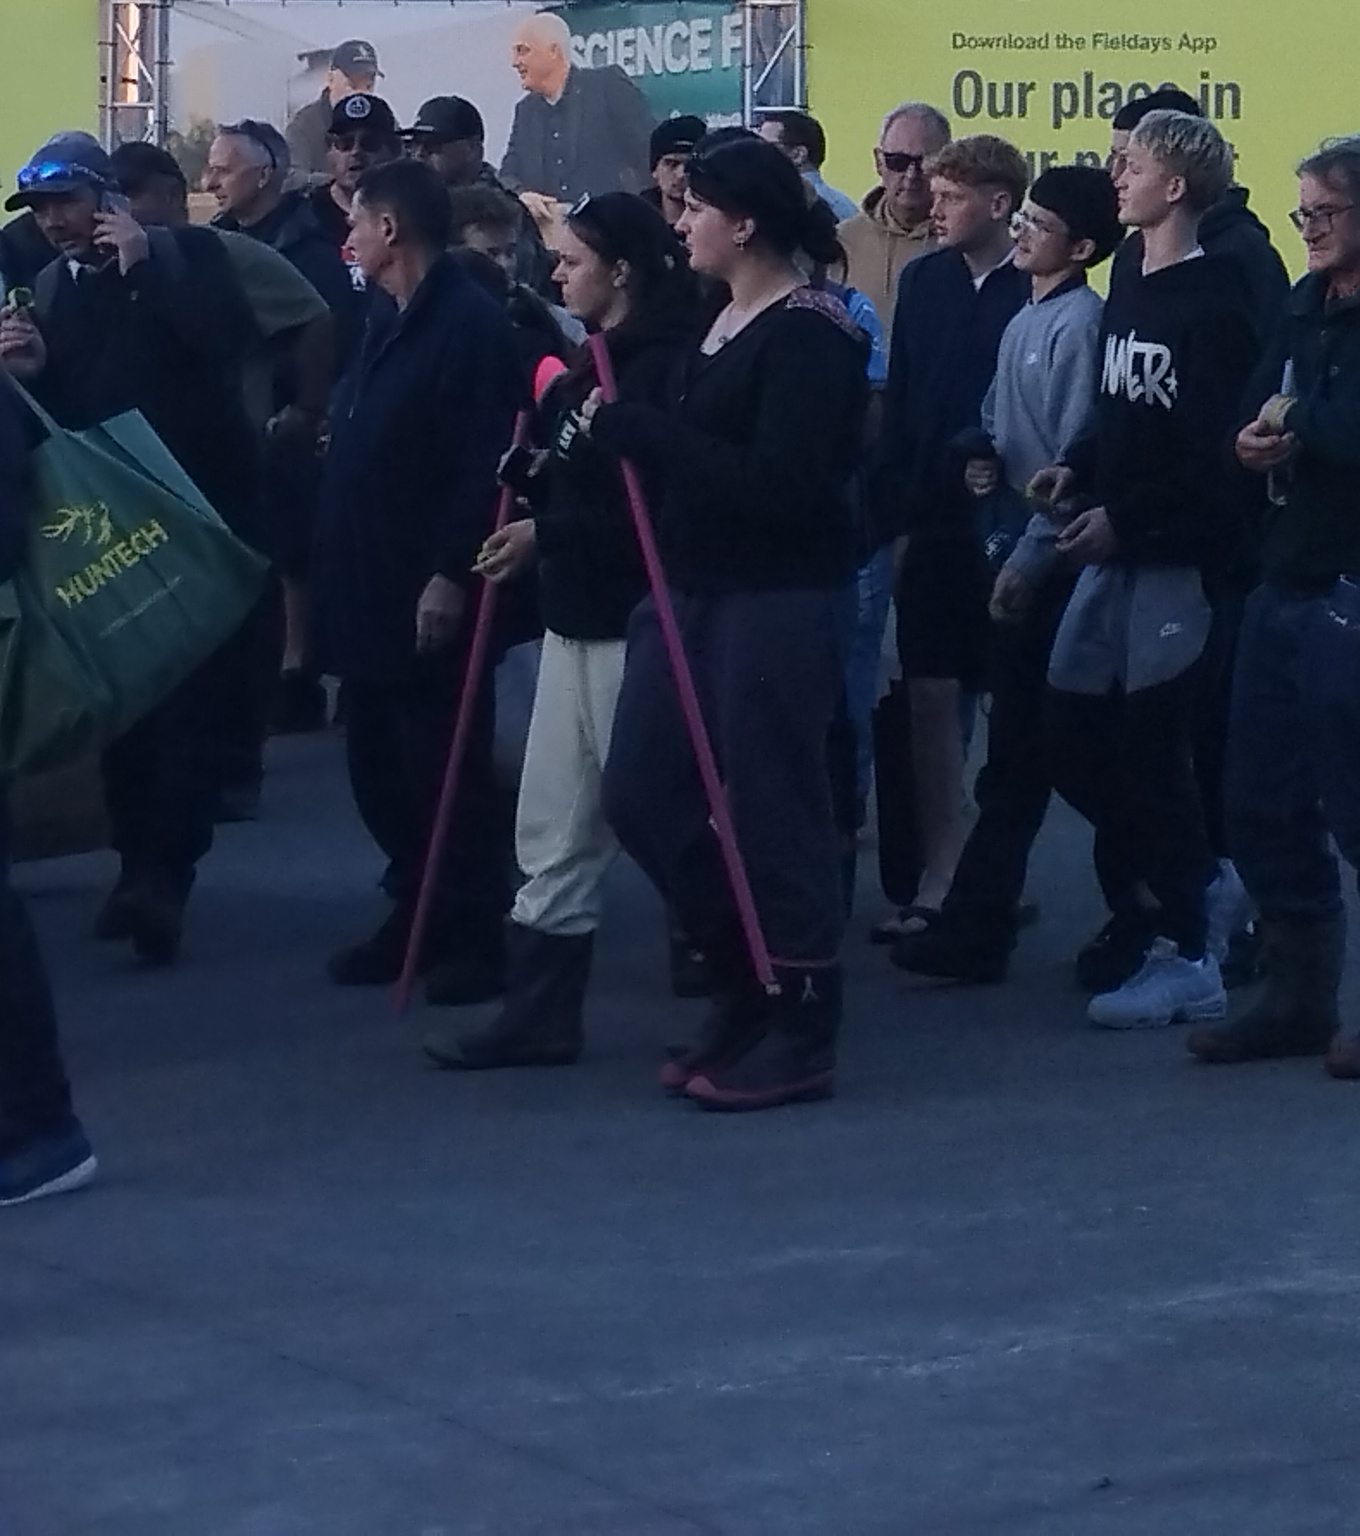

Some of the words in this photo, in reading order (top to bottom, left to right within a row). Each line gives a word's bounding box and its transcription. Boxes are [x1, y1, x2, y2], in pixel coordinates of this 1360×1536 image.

[569, 19, 713, 77] SCIENCE
[953, 33, 1050, 51] Download
[1056, 33, 1087, 51] the
[1093, 33, 1173, 55] Fieldays
[1179, 33, 1219, 55] App
[952, 69, 1037, 120] Our
[1200, 70, 1242, 120] in
[55, 518, 170, 609] HUNTECH
